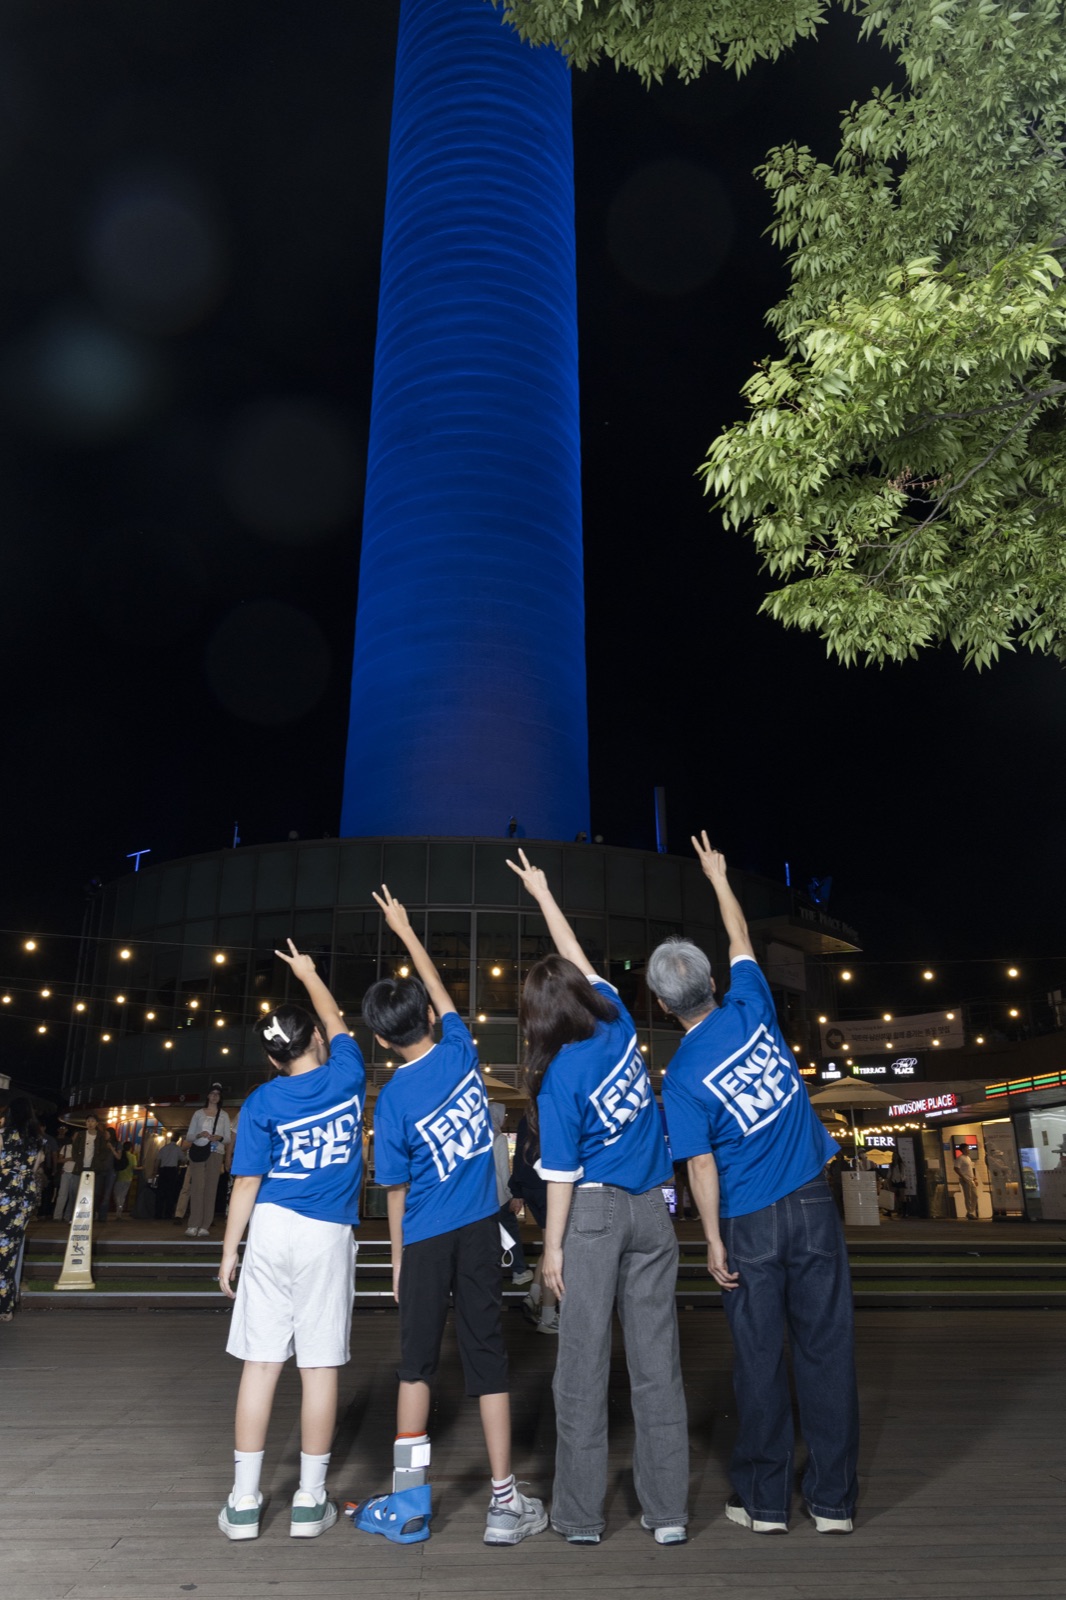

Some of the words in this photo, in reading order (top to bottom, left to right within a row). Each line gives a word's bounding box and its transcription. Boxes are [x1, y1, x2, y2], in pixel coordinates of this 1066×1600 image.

[718, 1042, 772, 1098] END
[734, 1057, 785, 1124] NF
[859, 1066, 886, 1074] TERRACE
[428, 1086, 482, 1145] END
[893, 1099, 927, 1116] TWOSOME
[927, 1094, 953, 1110] PLACE
